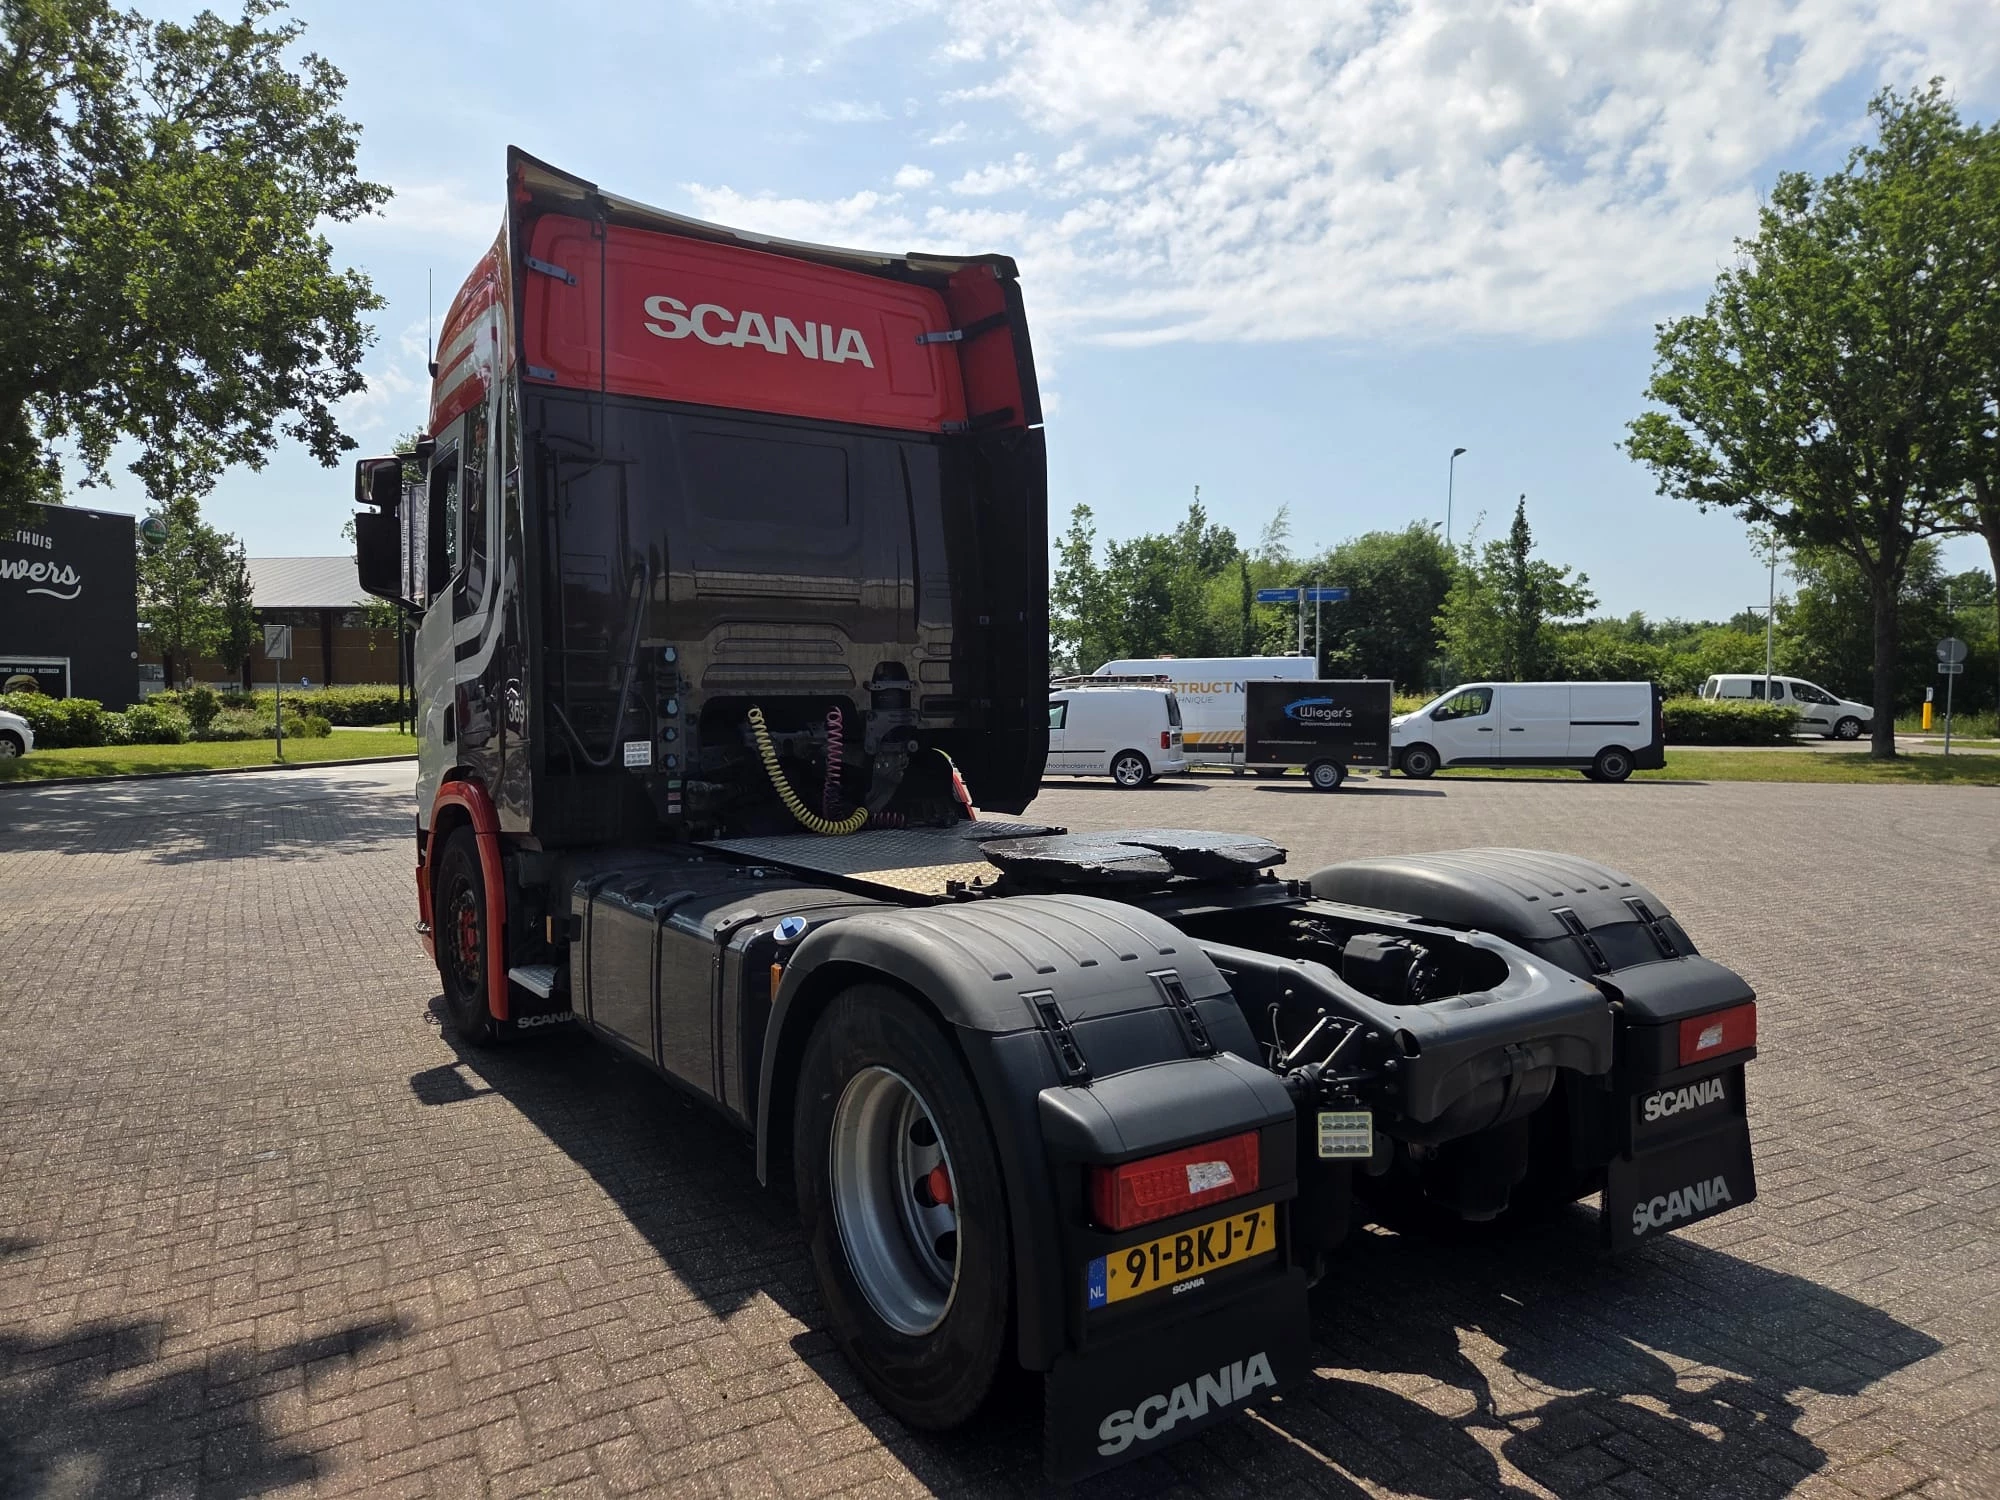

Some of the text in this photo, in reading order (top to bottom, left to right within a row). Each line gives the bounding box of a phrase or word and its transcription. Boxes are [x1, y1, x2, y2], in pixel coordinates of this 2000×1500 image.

[643, 295, 875, 369] SCANIA
[0, 529, 53, 550] THUIS
[508, 699, 525, 723] 369
[1175, 696, 1215, 705] HNIQUE
[1300, 706, 1353, 720] Wieger's
[1644, 1078, 1725, 1122] SCANIA
[1632, 1176, 1732, 1235] SCANIA
[1126, 1212, 1260, 1289] 91-BKJ-7
[1090, 1286, 1104, 1299] NL
[1172, 1277, 1205, 1295] SCANIA
[1097, 1352, 1278, 1457] SCANIA
